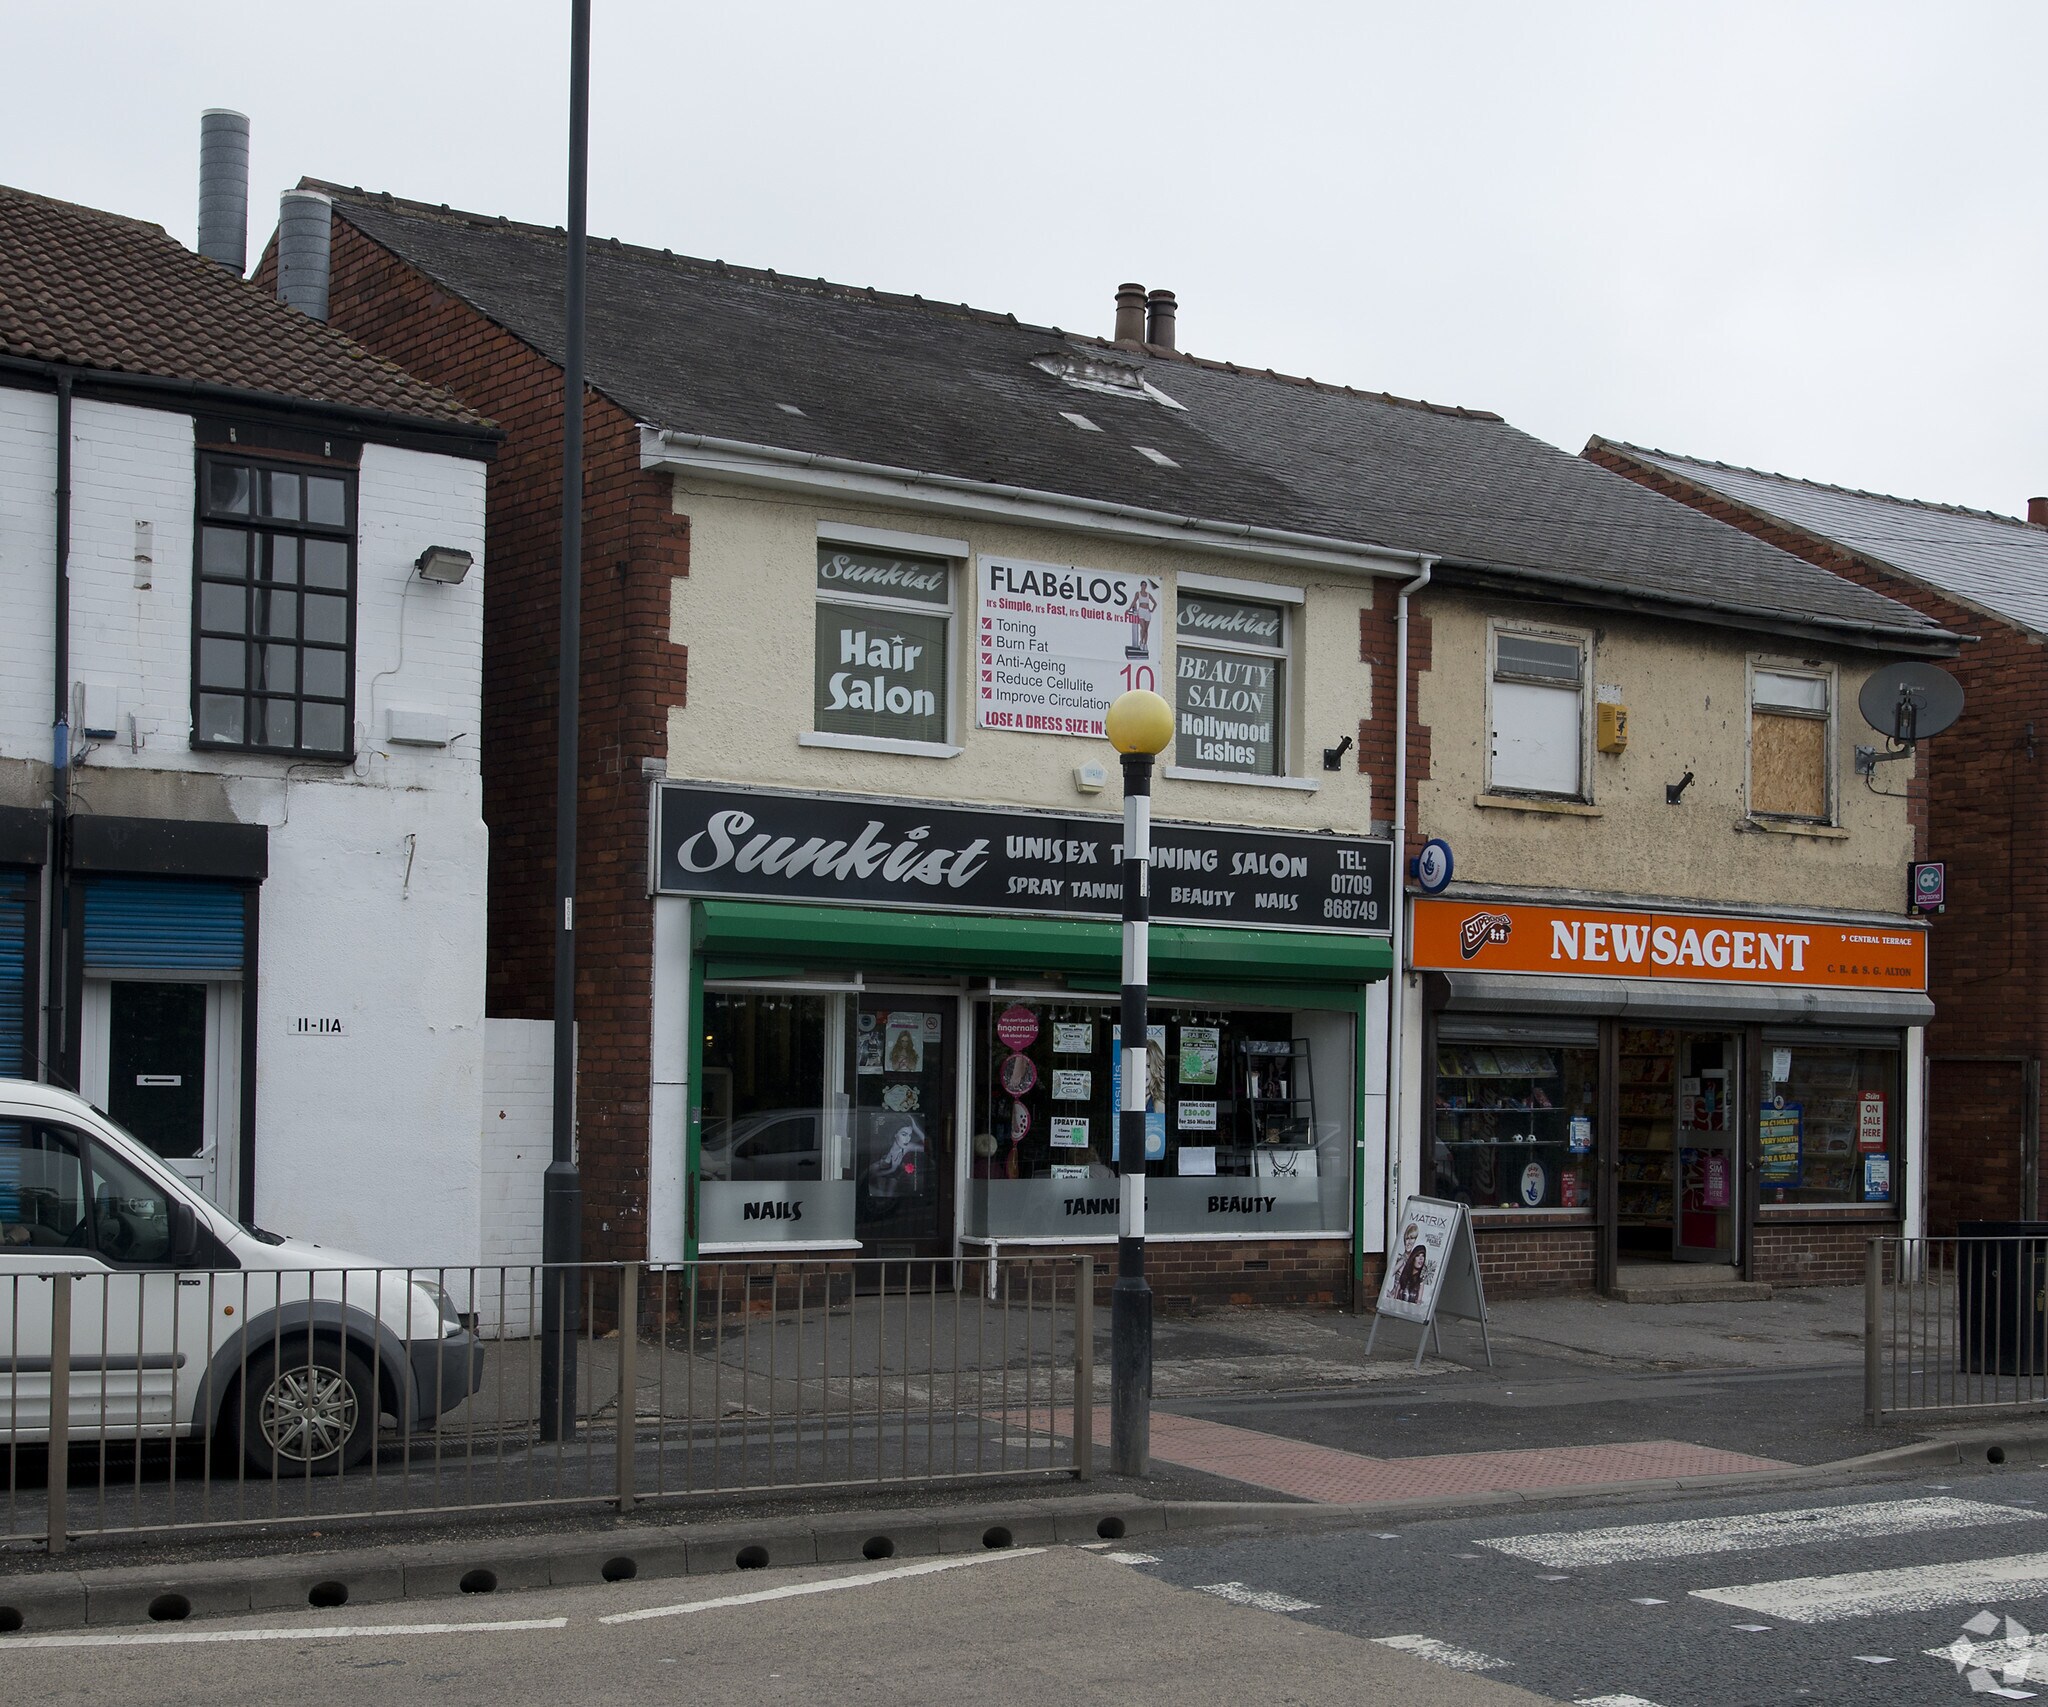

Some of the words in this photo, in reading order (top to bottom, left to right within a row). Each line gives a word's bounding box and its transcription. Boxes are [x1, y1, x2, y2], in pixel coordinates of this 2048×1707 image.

[821, 554, 943, 591] Sunkist
[990, 565, 1128, 606] FLABéLOS
[999, 597, 1034, 613] Simple,
[1046, 603, 1068, 616] Fast,
[1081, 606, 1105, 620] Quiet
[1106, 610, 1112, 620] &
[1177, 603, 1280, 637] Sunkist
[996, 618, 1036, 637] Toning
[840, 629, 923, 673] Hair
[996, 635, 1025, 650] Burn
[1030, 639, 1048, 652] Fat
[996, 654, 1066, 675] Anti-Ageing
[1177, 656, 1276, 688] BEAUTY
[996, 671, 1042, 687] Reduce
[1046, 677, 1094, 692] Cellulite
[1120, 663, 1155, 692] 10
[824, 672, 935, 717] Salon
[996, 688, 1045, 705] Improve
[1049, 694, 1111, 710] Circulation
[1188, 685, 1266, 714] SALON
[985, 711, 1013, 727] LOSE
[1015, 714, 1023, 728] A
[1026, 714, 1062, 732] DRESS
[1065, 718, 1088, 734] SIZE
[1091, 721, 1102, 734] IN
[1181, 713, 1270, 743] Hollywood
[1196, 738, 1256, 764] Lashes
[677, 809, 991, 889] Sunkist
[1006, 835, 1099, 865] UNISEX
[1229, 852, 1308, 879] SALON
[1336, 849, 1367, 870] TEL:
[1006, 876, 1064, 896] SPRAY
[1070, 880, 1123, 900] TANNI
[1170, 886, 1236, 907] BEAUTY
[1254, 892, 1300, 912] NAILS
[1330, 874, 1373, 896] 01709
[1323, 898, 1378, 922] 868749
[1550, 920, 1810, 972] NEWSAGENT
[1849, 935, 1880, 944] CENTRAL
[1882, 936, 1912, 946] TERRACE
[1851, 965, 1858, 974] &
[1885, 967, 1912, 976] ALTON
[997, 1024, 1039, 1032] fingernails
[1866, 1104, 1878, 1113] ON
[1864, 1116, 1881, 1125] SALE
[1862, 1128, 1881, 1137] HERE
[744, 1200, 804, 1222] NAILS
[1207, 1196, 1277, 1214] BEAUTY
[1410, 1212, 1448, 1227] MATRIX
